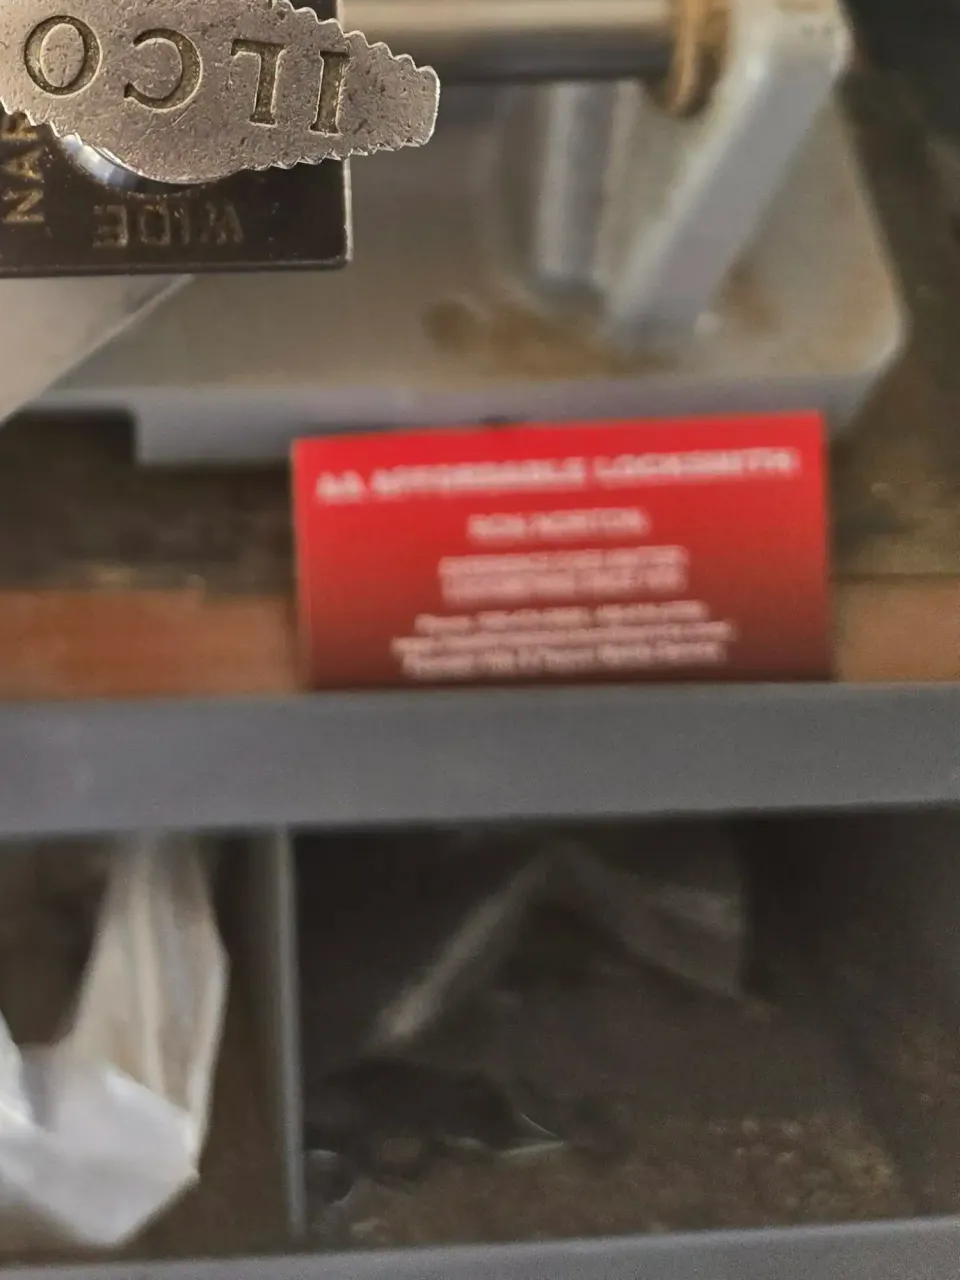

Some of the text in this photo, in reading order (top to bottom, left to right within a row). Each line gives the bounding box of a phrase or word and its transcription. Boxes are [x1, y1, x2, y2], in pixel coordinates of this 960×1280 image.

[24, 14, 349, 136] ILCO
[0, 112, 45, 224] NAR
[92, 199, 244, 249] WIDE
